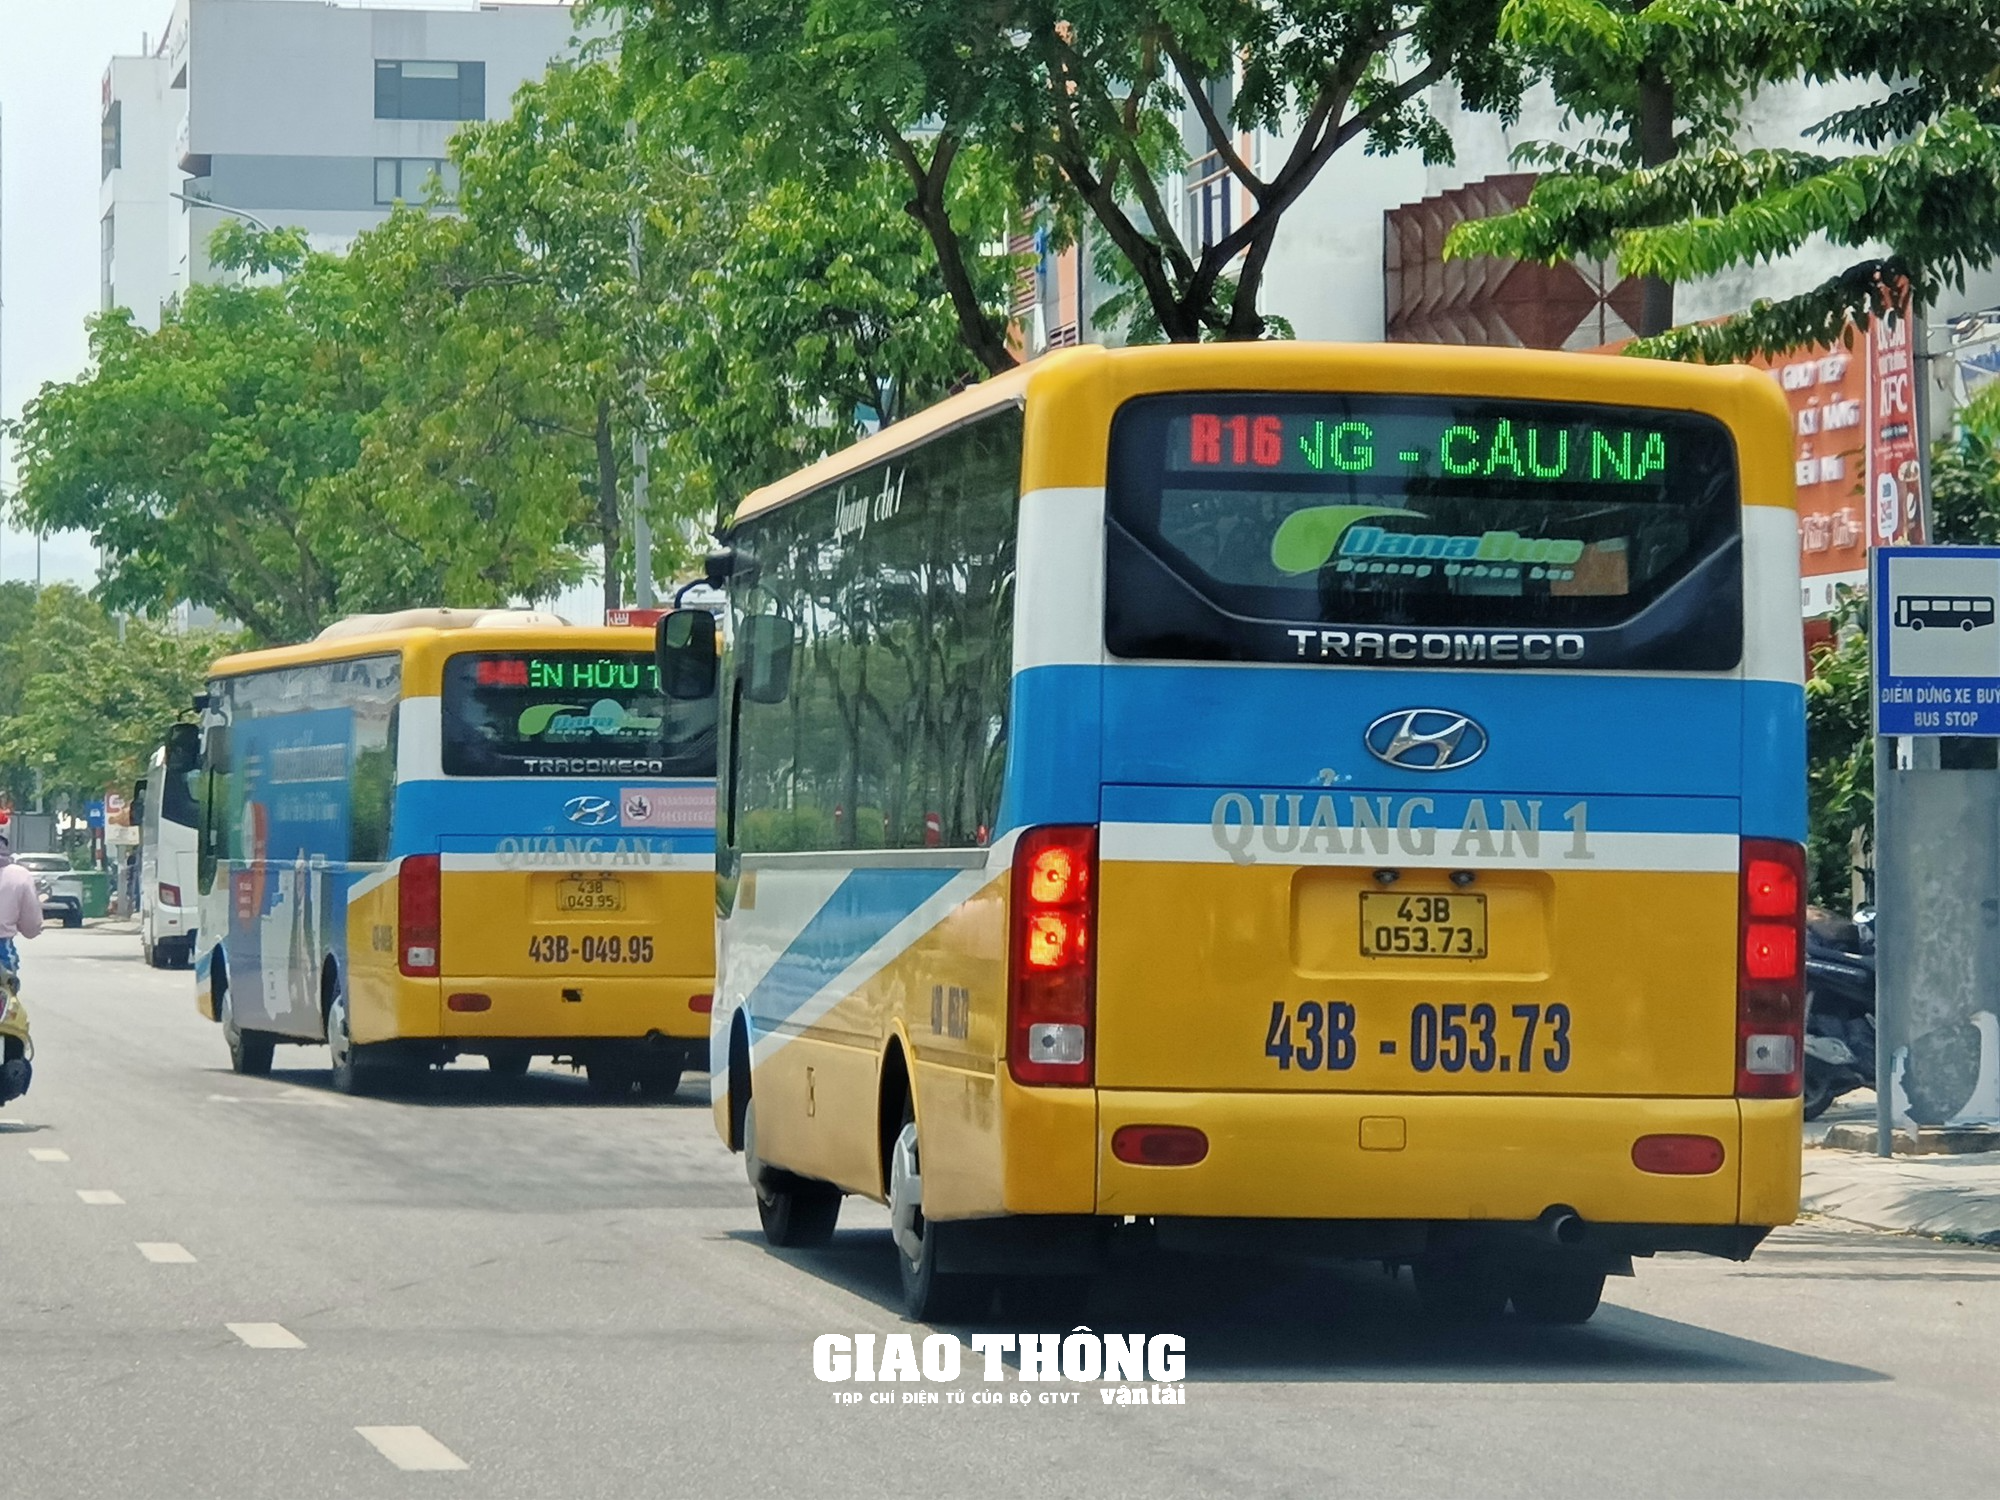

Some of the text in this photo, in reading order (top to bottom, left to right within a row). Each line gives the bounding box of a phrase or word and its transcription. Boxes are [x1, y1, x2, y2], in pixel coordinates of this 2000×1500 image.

[1880, 372, 1908, 418] KFC
[1191, 413, 1283, 467] R16
[1286, 628, 1586, 663] TRACOMECO
[1881, 679, 1913, 704] ĐIỂM
[1916, 681, 1952, 704] DỪNG
[1954, 687, 1972, 704] XE
[1914, 711, 1979, 727] BUS STOP
[523, 759, 663, 774] TRACOMECO
[1210, 768, 1596, 866] QUẢNG AN 1
[495, 826, 604, 869] QUẢNG
[610, 837, 653, 866] AN
[577, 880, 604, 894] 43B
[567, 895, 616, 909] 049.95
[1397, 897, 1451, 923] 43B
[528, 935, 654, 964] 43B-049.95
[1375, 926, 1474, 954] 053.73
[1265, 1000, 1357, 1073] 43B
[1410, 1002, 1572, 1074] 053.73
